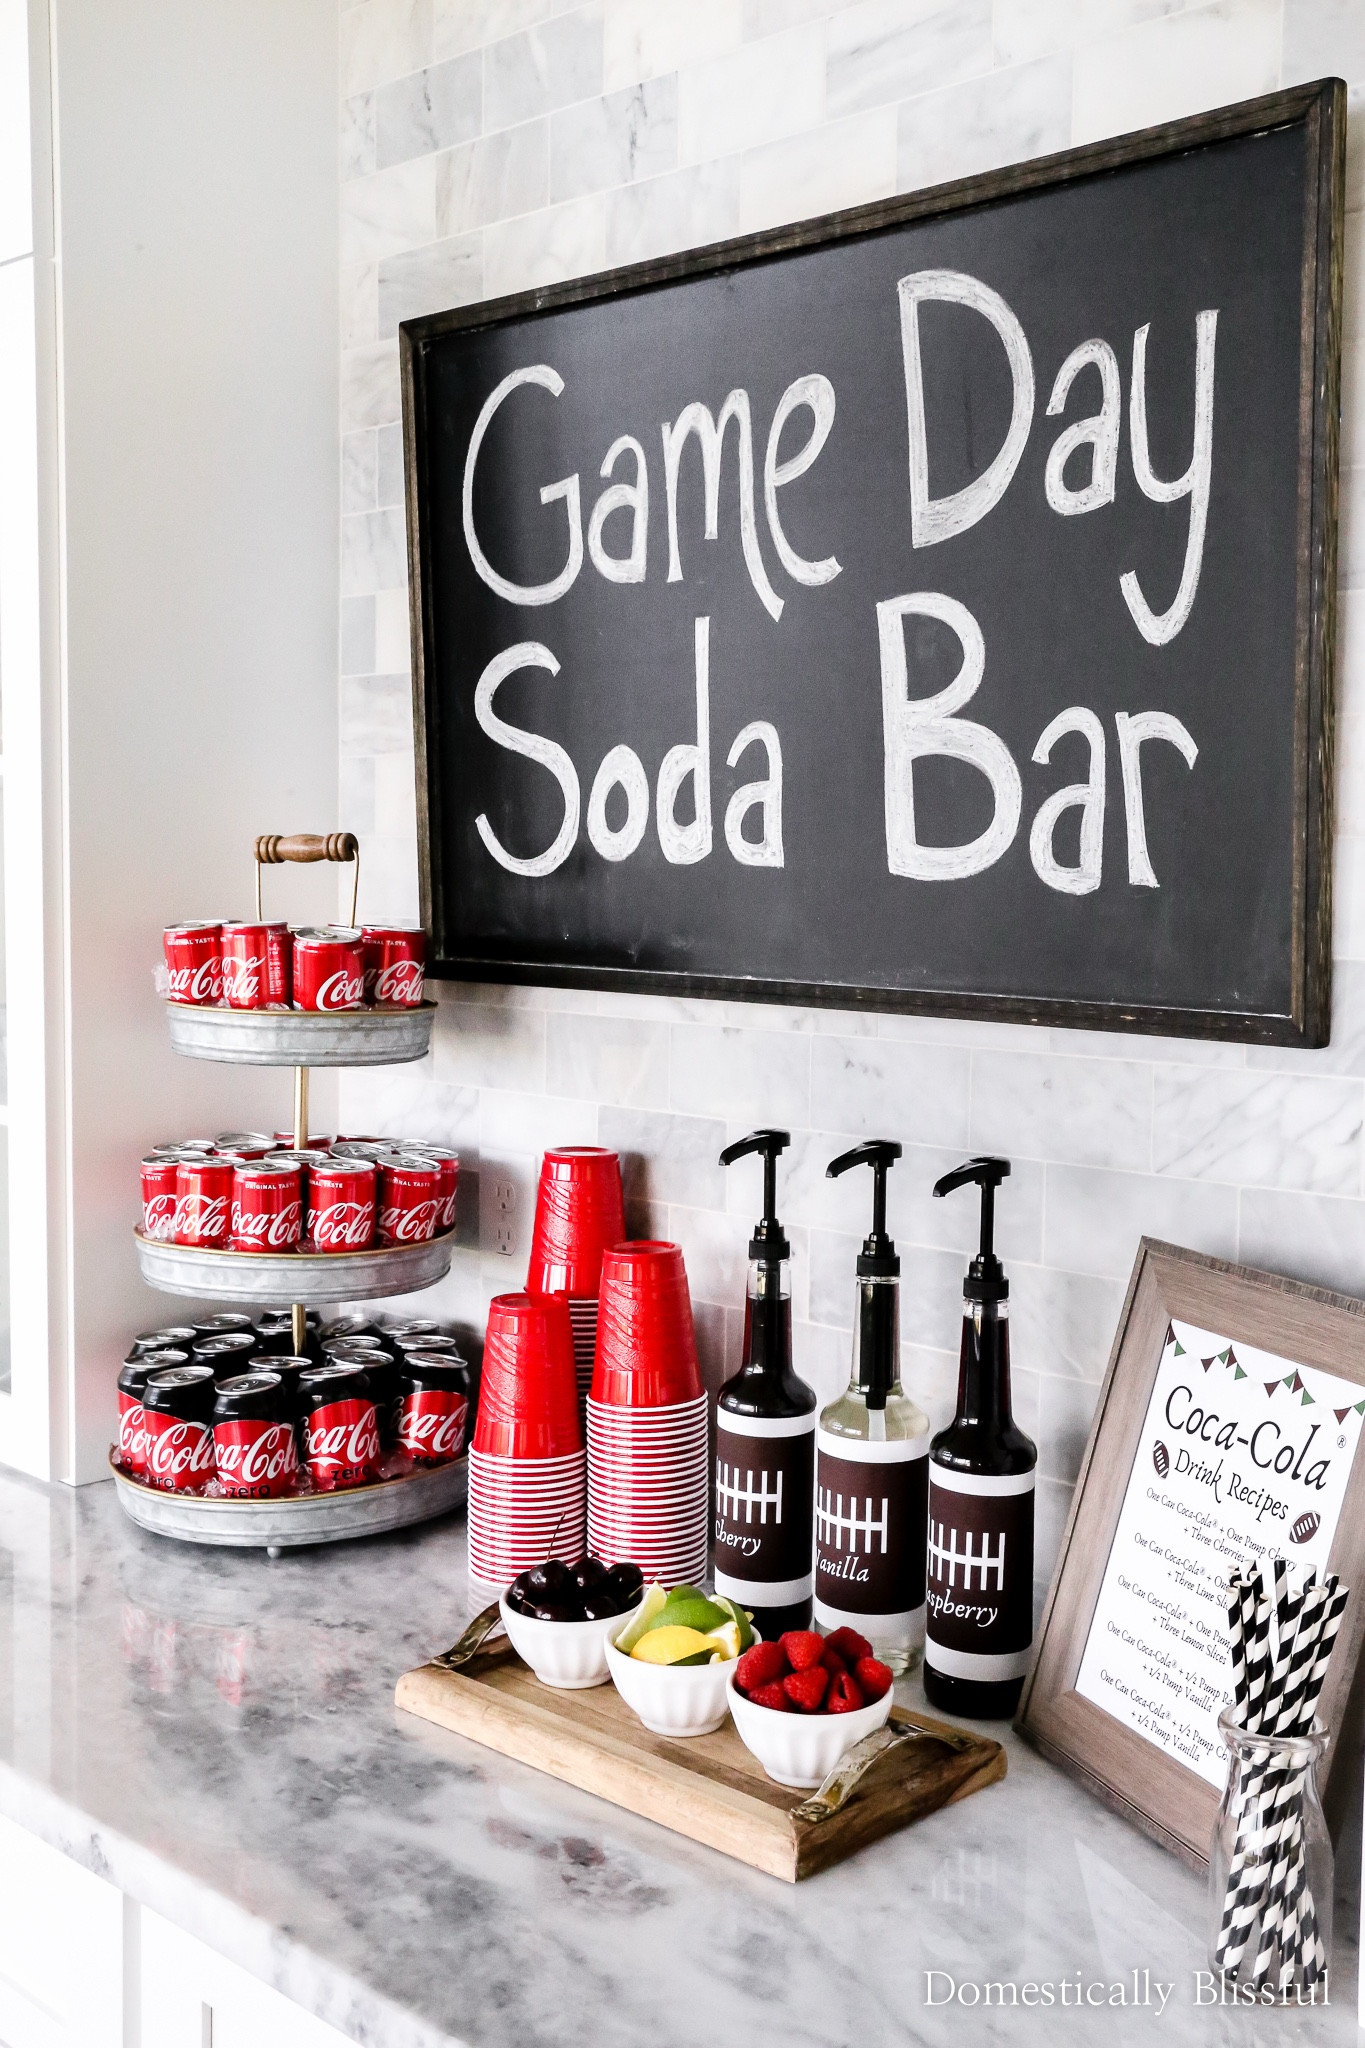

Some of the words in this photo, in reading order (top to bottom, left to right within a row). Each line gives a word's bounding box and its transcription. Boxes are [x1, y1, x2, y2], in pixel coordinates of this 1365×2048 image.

[462, 364, 843, 623] Game
[898, 269, 1219, 647] Day
[474, 616, 785, 878] Soda
[876, 591, 1200, 897] Bar
[1165, 1385, 1331, 1491] Coca-Cola
[153, 1474, 175, 1488] ero
[1174, 1448, 1224, 1504] Drink
[1227, 1472, 1289, 1522] Recipes
[715, 1518, 761, 1556] Cherry
[1134, 1532, 1148, 1547] One
[1149, 1540, 1163, 1555] Can
[1146, 1487, 1160, 1502] One
[1161, 1494, 1175, 1510] Can
[1227, 1527, 1243, 1544] One
[1244, 1535, 1267, 1559] Pump
[1191, 1526, 1212, 1546] Three
[1213, 1538, 1246, 1563] Cherries
[1117, 1574, 1131, 1590] One
[1132, 1583, 1146, 1599] Can
[1196, 1620, 1211, 1637] One
[1174, 1570, 1195, 1591] Three
[1195, 1583, 1214, 1602] Lime
[1107, 1620, 1121, 1636] One
[1121, 1629, 1136, 1646] Can
[1185, 1671, 1198, 1685] 1/2
[1198, 1677, 1221, 1703] Pump
[1159, 1616, 1180, 1637] Three
[1180, 1629, 1204, 1652] Lemon
[1205, 1644, 1227, 1665] Slices
[1100, 1668, 1114, 1686] One
[1114, 1678, 1129, 1696] Can
[1178, 1723, 1191, 1738] 1/2
[1192, 1729, 1215, 1756] Pump
[1148, 1667, 1161, 1681] 1/2
[1162, 1672, 1183, 1698] Pump
[1184, 1686, 1213, 1713] Vanilla
[1137, 1714, 1149, 1728] 1/2
[1150, 1720, 1171, 1746] Pump
[1172, 1734, 1201, 1762] Vanilla
